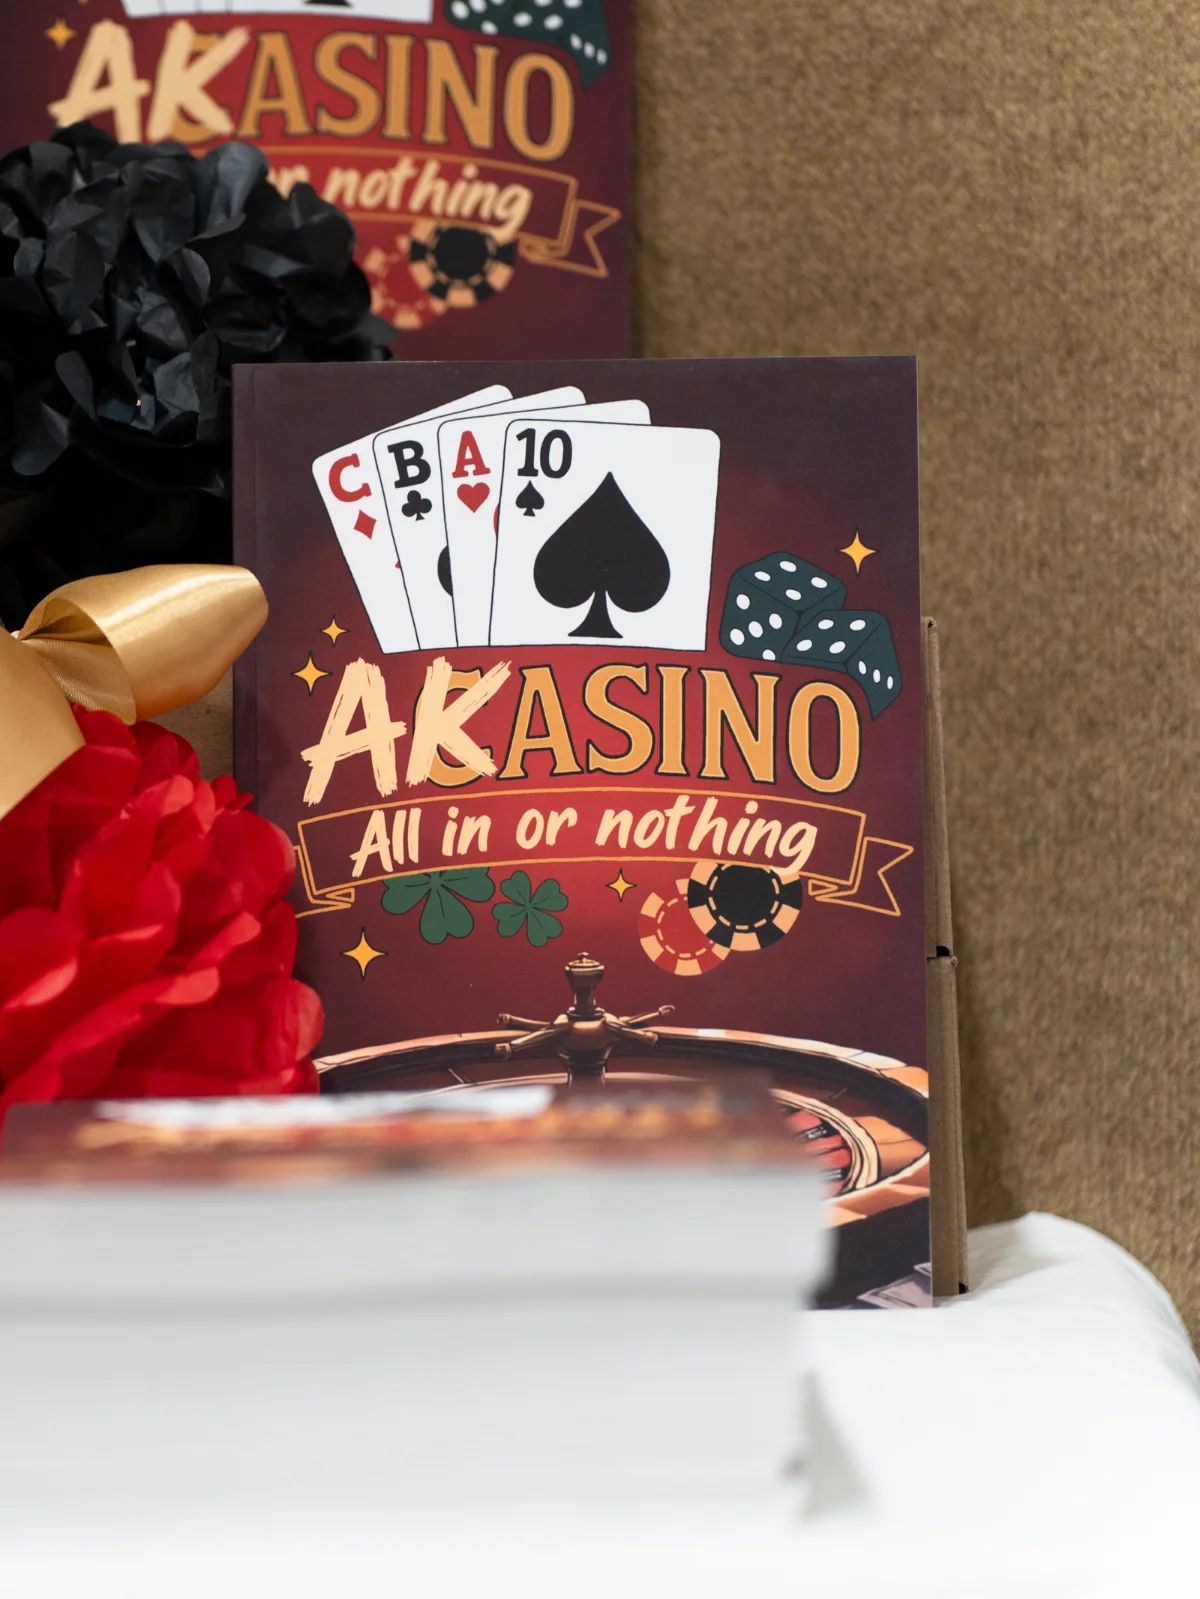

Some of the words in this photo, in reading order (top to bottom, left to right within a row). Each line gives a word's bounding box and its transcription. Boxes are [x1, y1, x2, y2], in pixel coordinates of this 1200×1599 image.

[266, 163, 310, 200] r
[321, 156, 533, 242] nothing
[327, 453, 372, 503] C
[387, 439, 432, 489] B
[451, 430, 490, 479] A
[515, 428, 573, 480] 10
[350, 807, 422, 878] All
[441, 806, 492, 857] in
[515, 806, 578, 850] or
[594, 795, 818, 876] nothing
